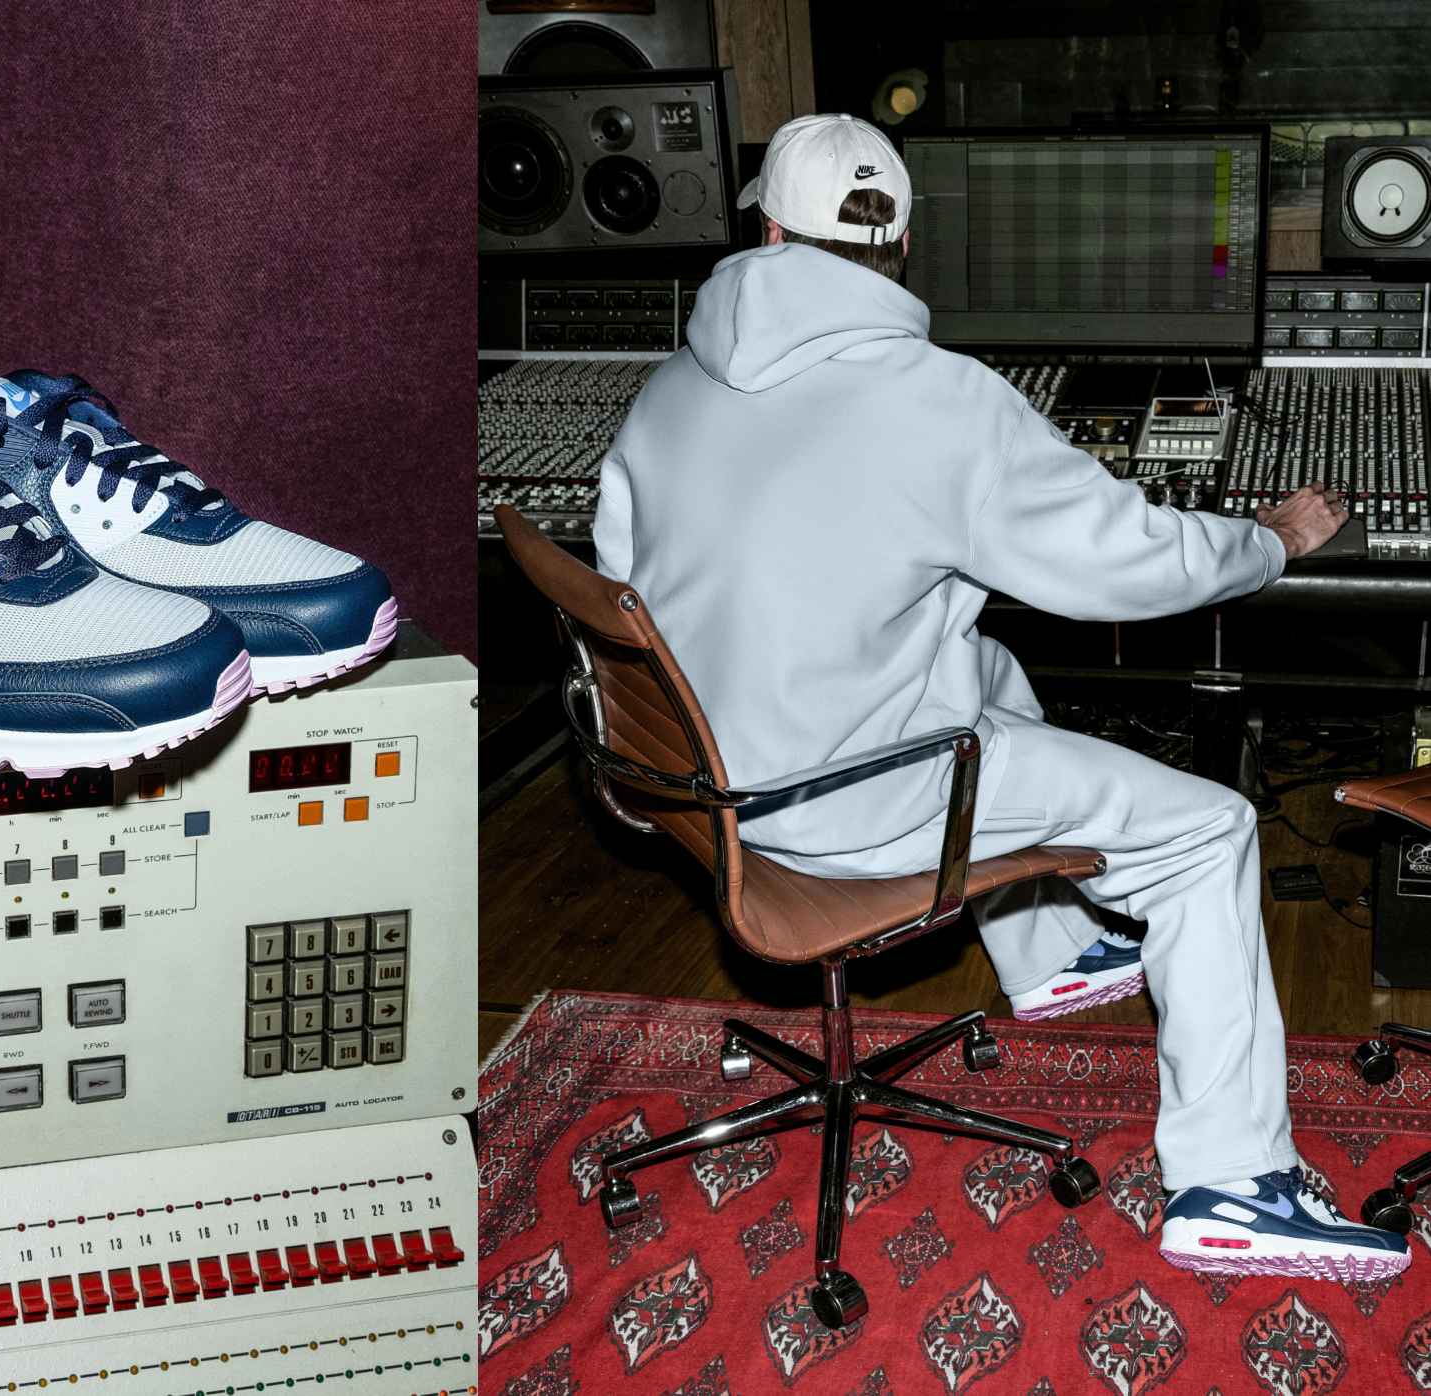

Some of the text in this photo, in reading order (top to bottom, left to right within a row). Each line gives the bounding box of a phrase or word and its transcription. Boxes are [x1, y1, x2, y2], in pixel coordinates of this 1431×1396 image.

[858, 165, 876, 174] NIKE
[306, 727, 363, 738] STOP WATCH
[377, 740, 399, 748] RESET
[376, 801, 396, 809] STOP
[49, 815, 62, 823] min
[251, 811, 291, 821] START/LAP
[122, 823, 166, 834] ALL CLEAR
[15, 844, 21, 855] 7
[62, 839, 69, 850] 8
[110, 834, 116, 845] 9
[143, 853, 172, 863] STORE
[143, 907, 178, 918] SEARCH
[266, 931, 355, 955] 7 8 9
[265, 967, 401, 994] 4 5 6 LOAD
[88, 998, 109, 1008] AUTO
[1, 1010, 31, 1020] SHUTTLE
[84, 1008, 114, 1018] REWIND
[265, 1007, 353, 1031] 1 2 3
[264, 1053, 272, 1069] 0
[340, 1046, 357, 1059] STO
[335, 1094, 404, 1109] AUTO LOCATOR
[20, 1250, 33, 1263] 10
[50, 1246, 63, 1259] 11
[80, 1242, 93, 1255] 12
[110, 1238, 123, 1251] 13
[140, 1234, 152, 1247] 14
[169, 1230, 182, 1243] 15
[198, 1227, 211, 1240] 16
[228, 1223, 240, 1236] 17
[257, 1219, 270, 1232] 18
[286, 1215, 299, 1228] 19
[314, 1212, 327, 1225] 20
[343, 1208, 356, 1221] 21
[372, 1204, 385, 1217] 22
[400, 1201, 413, 1213] 23
[429, 1197, 441, 1210] 24
